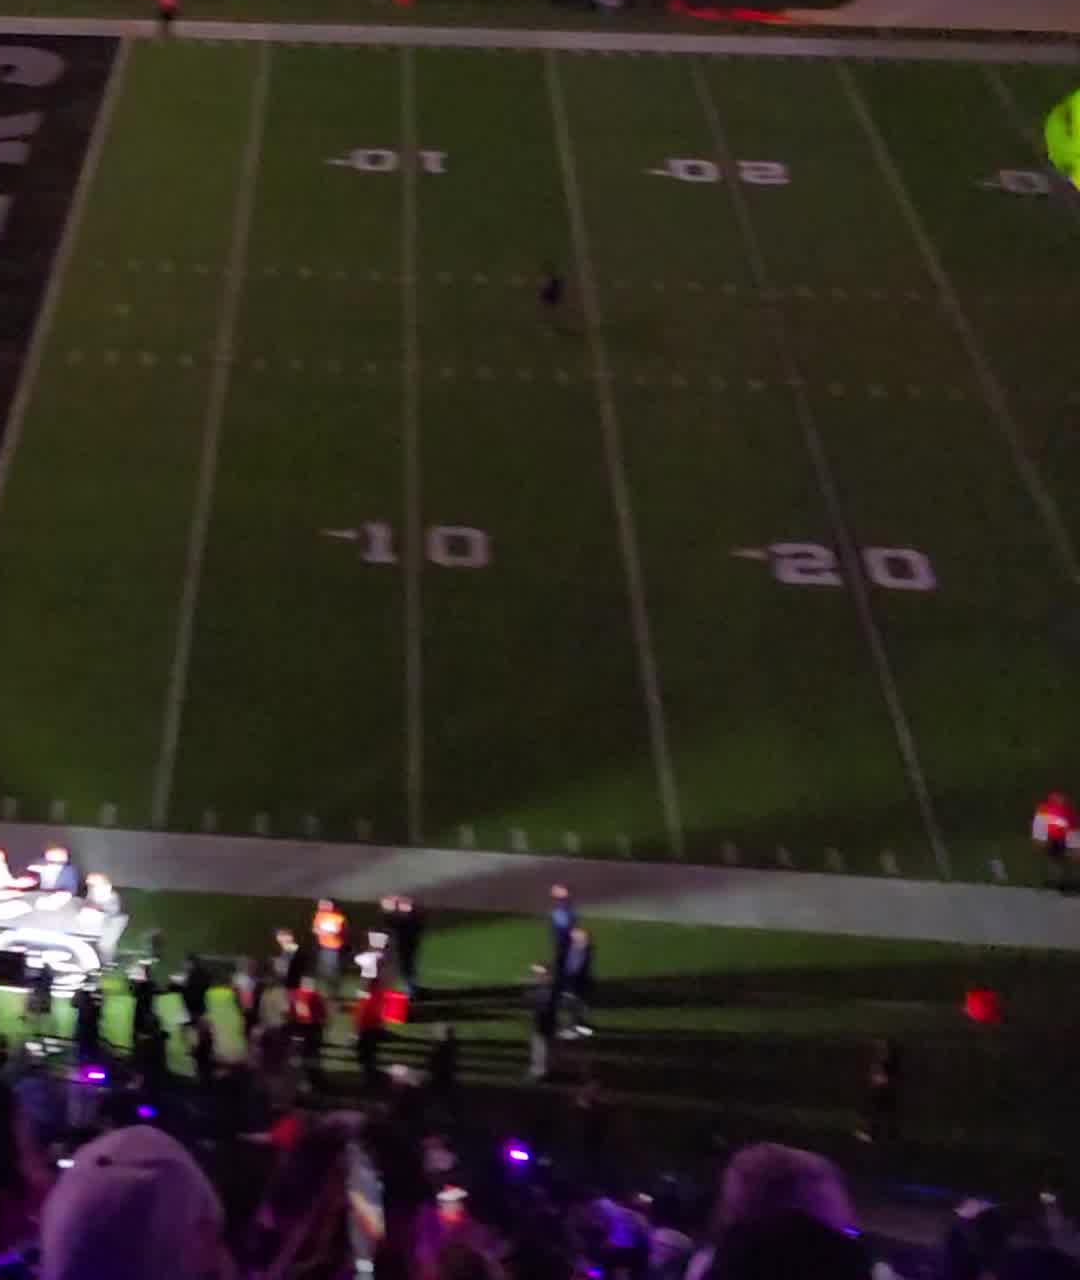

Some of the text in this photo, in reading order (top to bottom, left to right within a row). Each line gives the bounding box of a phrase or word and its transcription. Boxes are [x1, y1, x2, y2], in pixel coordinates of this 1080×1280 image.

[349, 148, 448, 174] 10
[665, 158, 791, 185] 20
[360, 520, 493, 569] 10
[766, 541, 938, 592] 20
